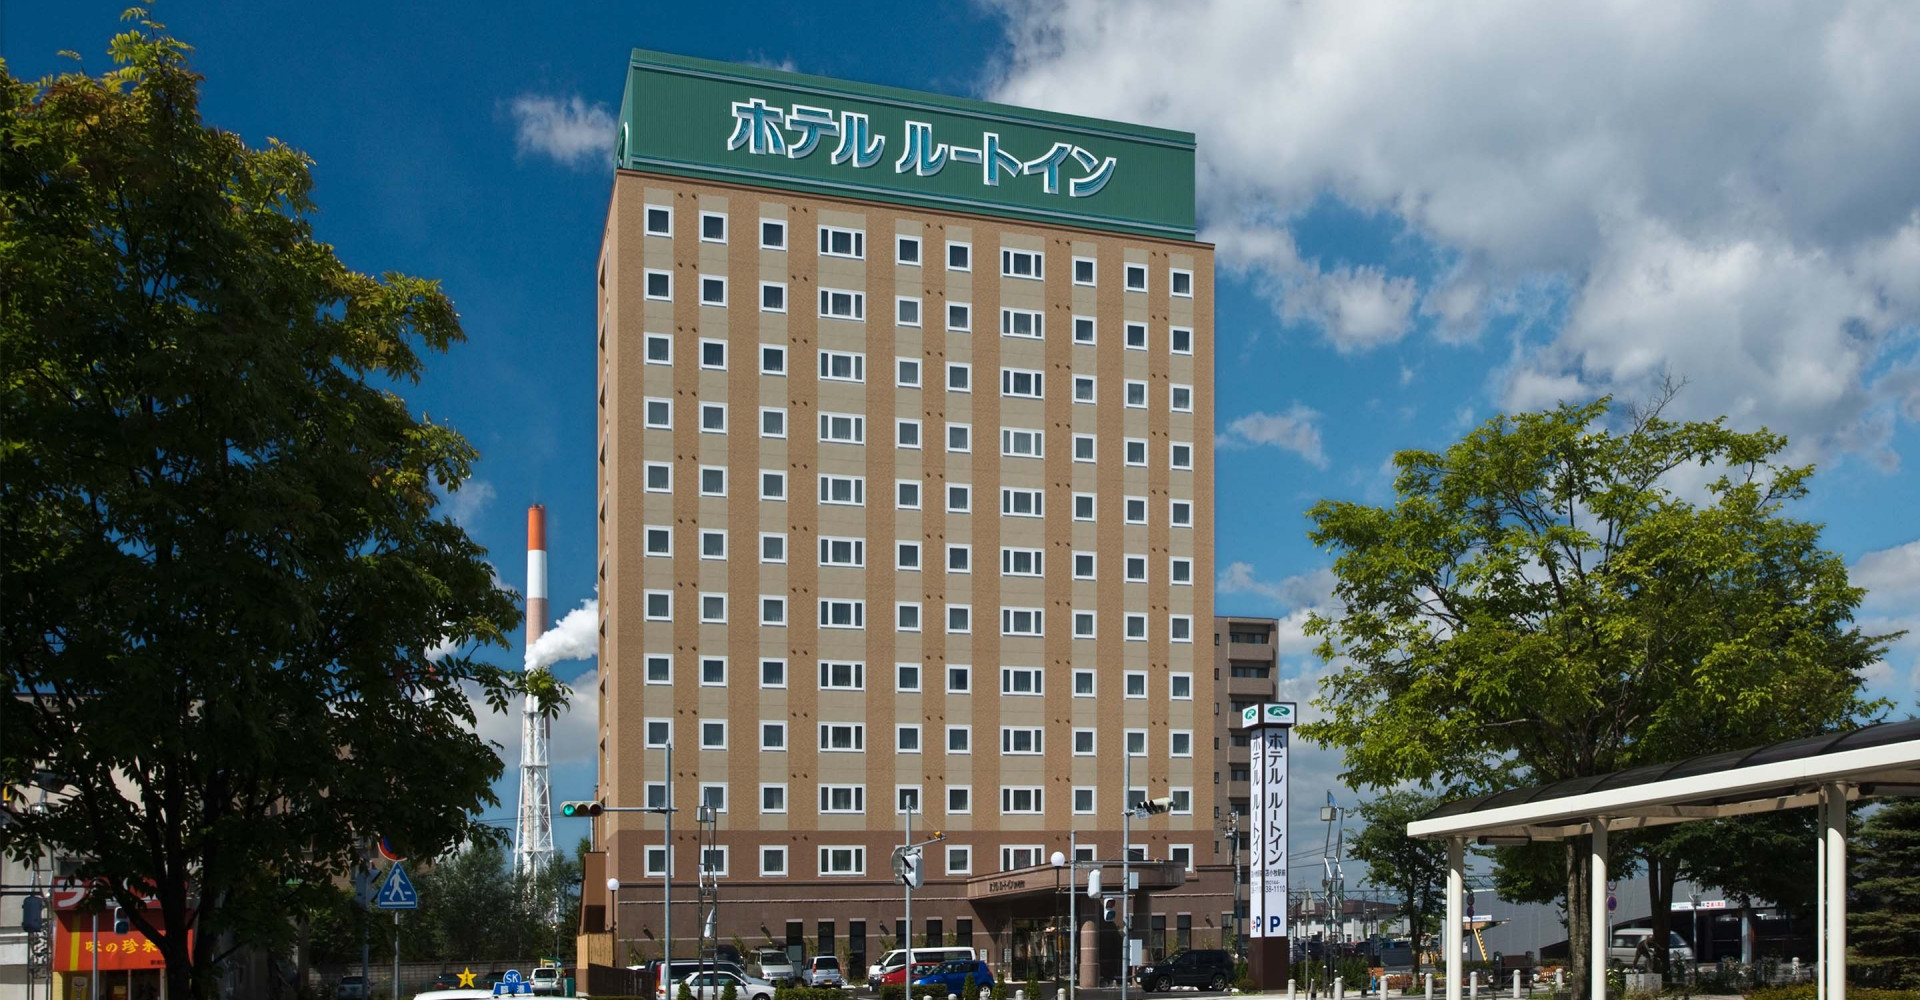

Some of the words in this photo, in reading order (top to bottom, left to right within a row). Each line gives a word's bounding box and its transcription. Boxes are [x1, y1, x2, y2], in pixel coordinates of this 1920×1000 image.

[728, 98, 885, 168] ホテル
[895, 120, 1117, 197] ルートイン
[1252, 734, 1261, 786] ホテル
[1268, 733, 1284, 784] ホテル
[1252, 793, 1261, 867] ルートイン
[1268, 792, 1284, 866] ルートイン
[1256, 916, 1262, 933] P
[1270, 916, 1281, 933] P
[505, 973, 519, 984] SK
